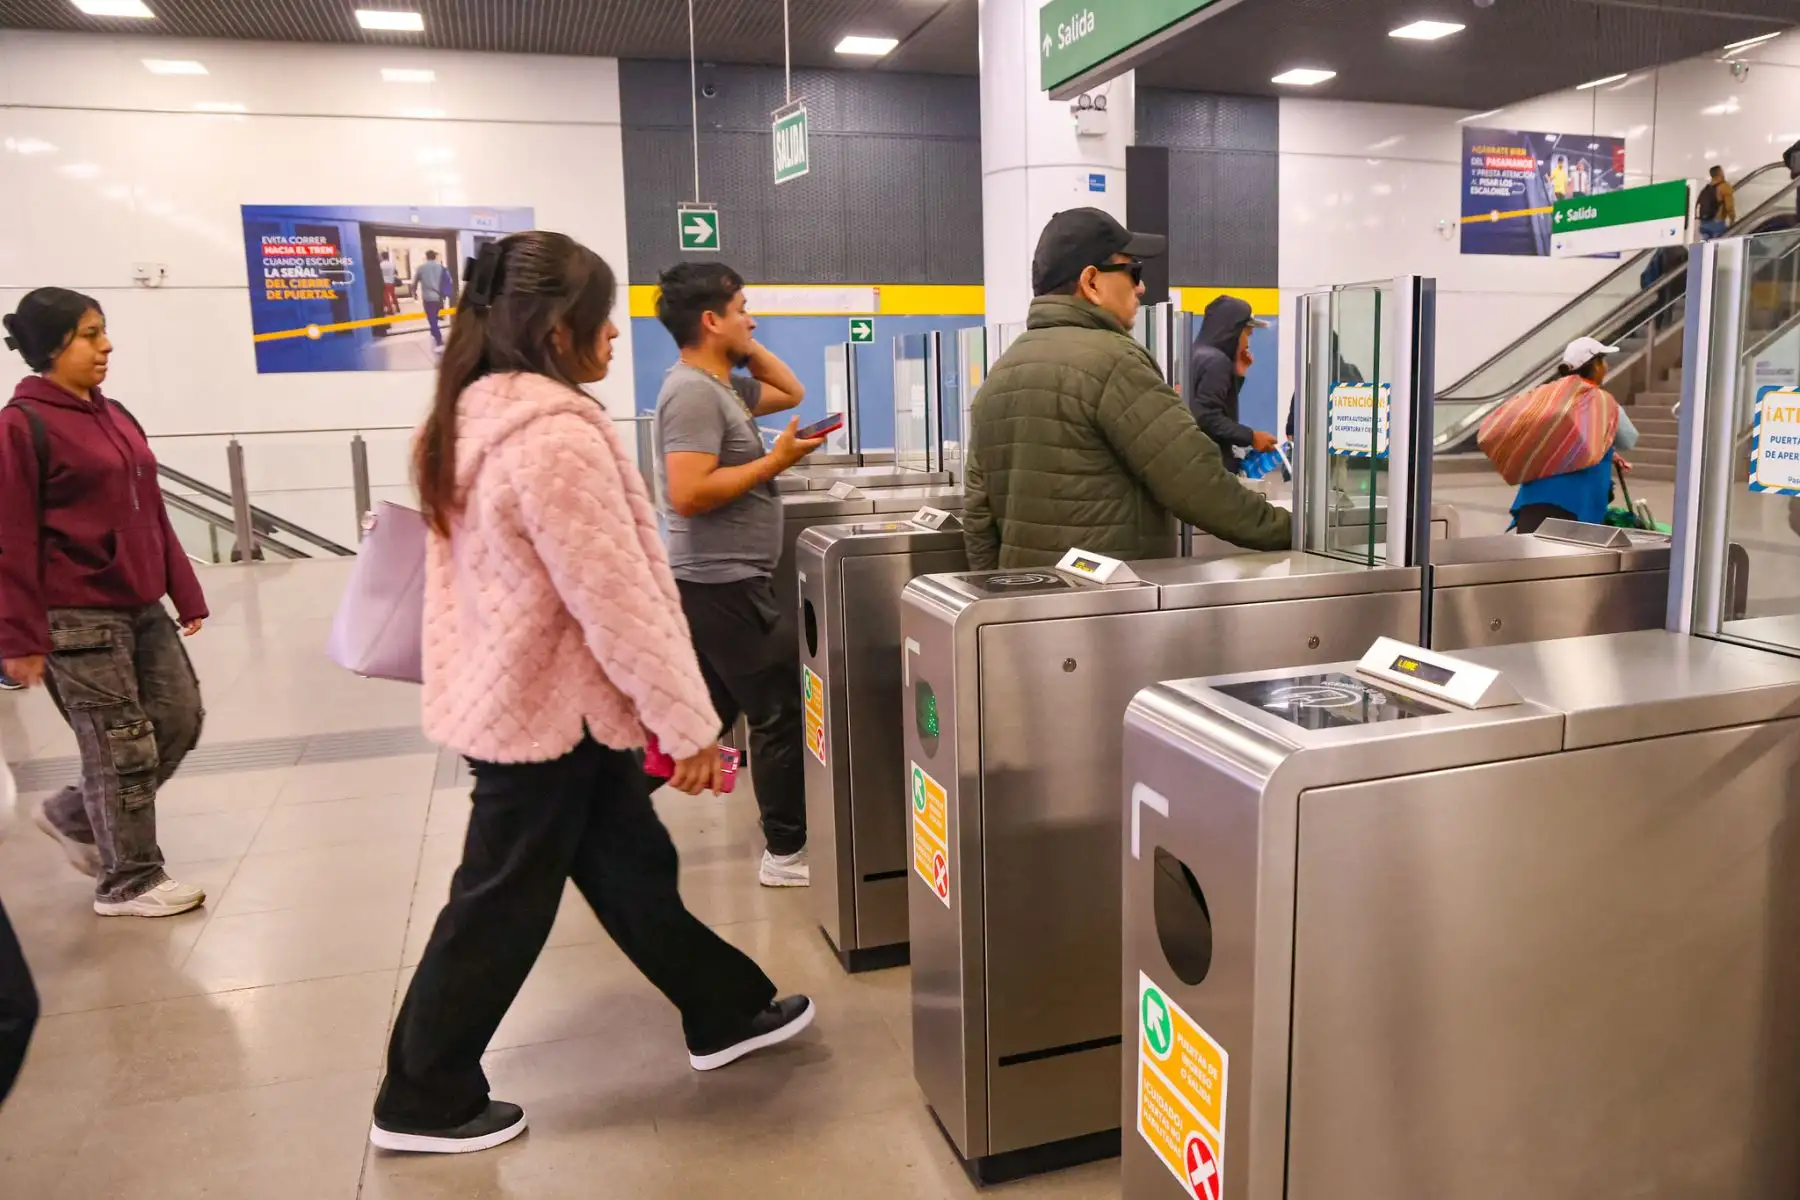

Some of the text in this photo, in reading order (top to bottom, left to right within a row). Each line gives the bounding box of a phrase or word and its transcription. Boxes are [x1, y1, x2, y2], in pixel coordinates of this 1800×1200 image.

[1058, 9, 1095, 50] Salida
[777, 121, 805, 172] SALIDA
[1567, 205, 1597, 222] Salida
[262, 236, 327, 244] EVITA CORRER
[264, 246, 334, 255] HACIA EL TREN
[262, 257, 353, 266] CUANDO ESCUCHES
[264, 266, 319, 278] LA SEÑAL
[265, 278, 331, 289] DEL CIERRE
[266, 290, 283, 300] DE
[1765, 450, 1776, 459] DE
[1177, 1031, 1218, 1080] PUERTAS DE
[1181, 1067, 1212, 1106] O SALIDA
[1144, 1093, 1180, 1143] PUERTAS NO
